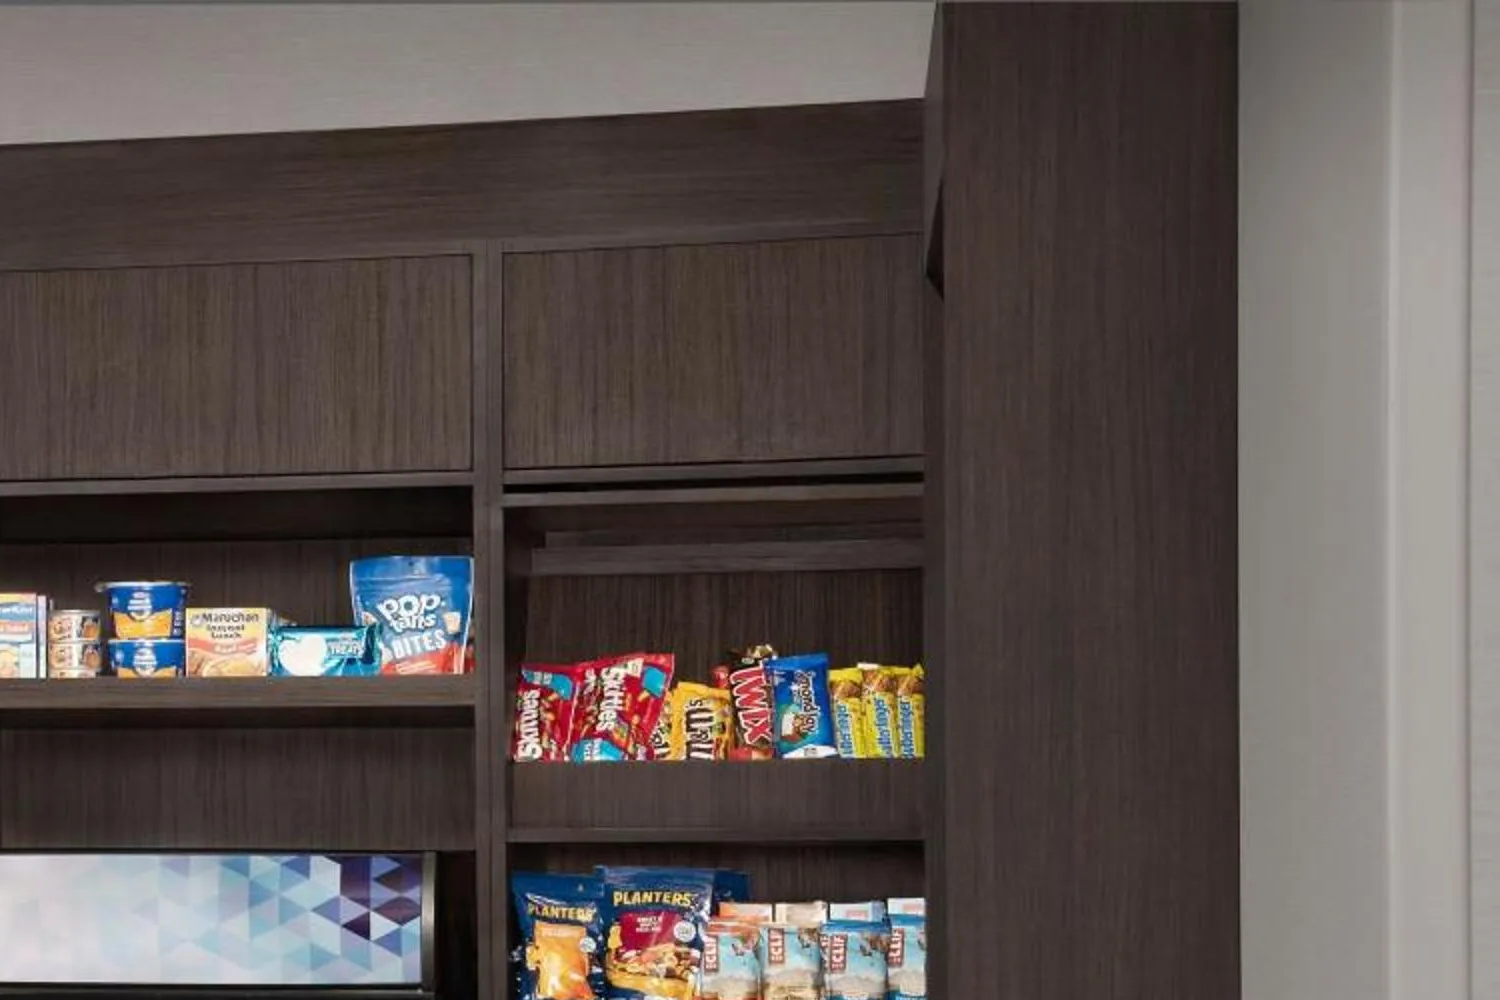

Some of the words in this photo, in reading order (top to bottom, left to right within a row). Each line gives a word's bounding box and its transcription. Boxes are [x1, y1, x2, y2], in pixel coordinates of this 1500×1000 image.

[201, 612, 260, 623] Maruchan
[391, 630, 447, 658] BITES
[612, 889, 693, 908] PLANTERS
[527, 902, 598, 922] PLANTERS
